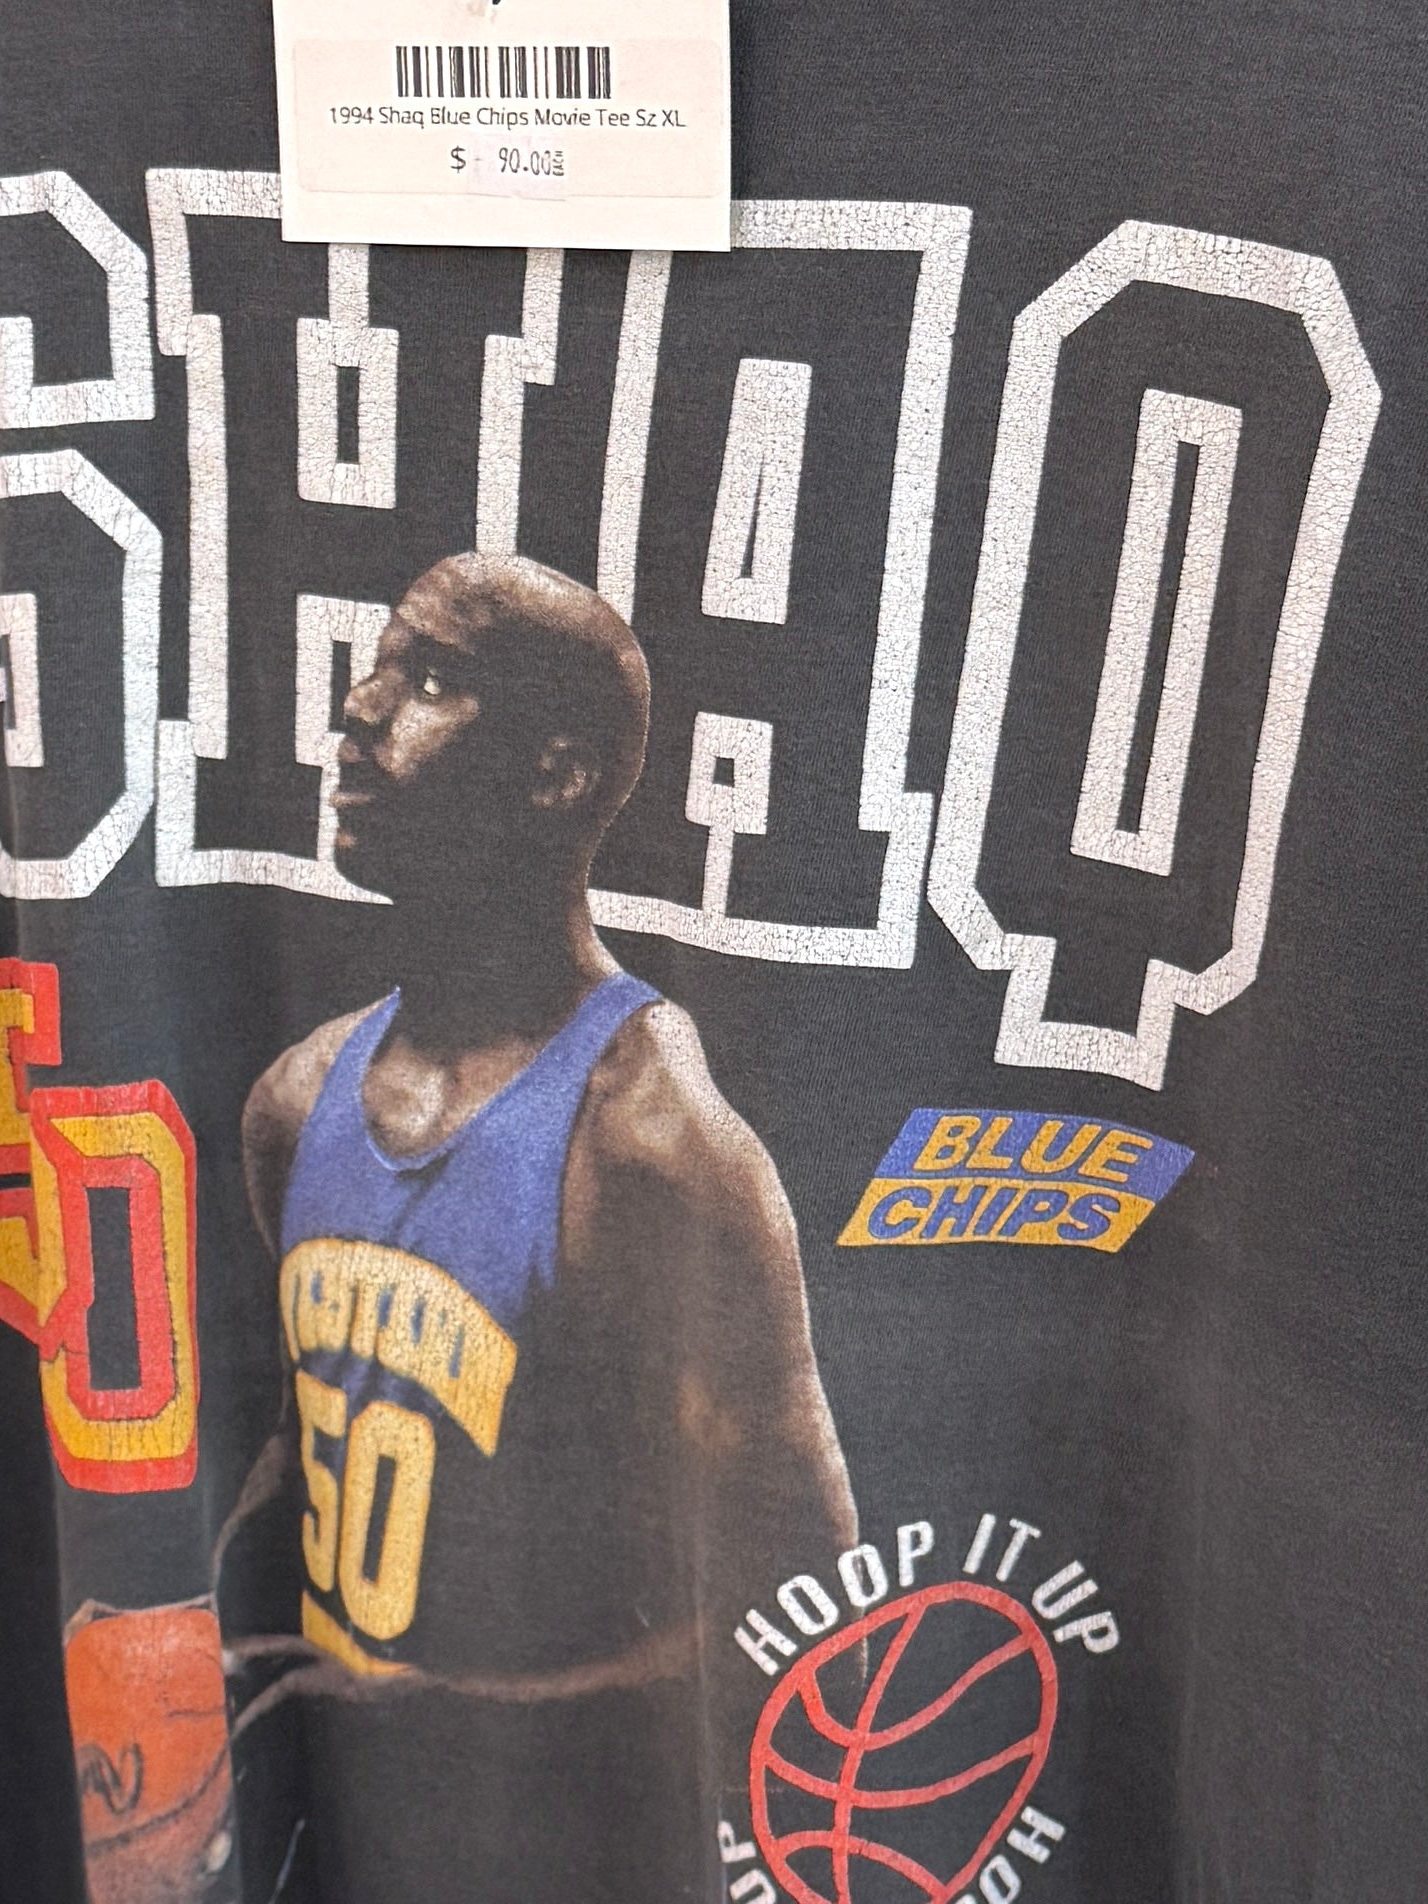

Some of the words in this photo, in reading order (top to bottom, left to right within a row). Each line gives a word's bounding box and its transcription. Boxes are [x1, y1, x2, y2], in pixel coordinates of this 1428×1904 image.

[329, 106, 374, 125] 1994
[378, 106, 425, 129] Shaq
[430, 106, 471, 125] Blue
[476, 106, 529, 130] Chips
[534, 107, 591, 127] Movie
[595, 108, 630, 127] Tee
[635, 108, 657, 127] Sz
[661, 109, 687, 127] XL
[912, 1114, 1154, 1183] BLUE
[867, 1186, 1121, 1242] CHIPS
[295, 1367, 438, 1641] 50
[733, 1520, 935, 1676] HOOP
[962, 1513, 1042, 1582] IT
[1031, 1560, 1121, 1654] UP
